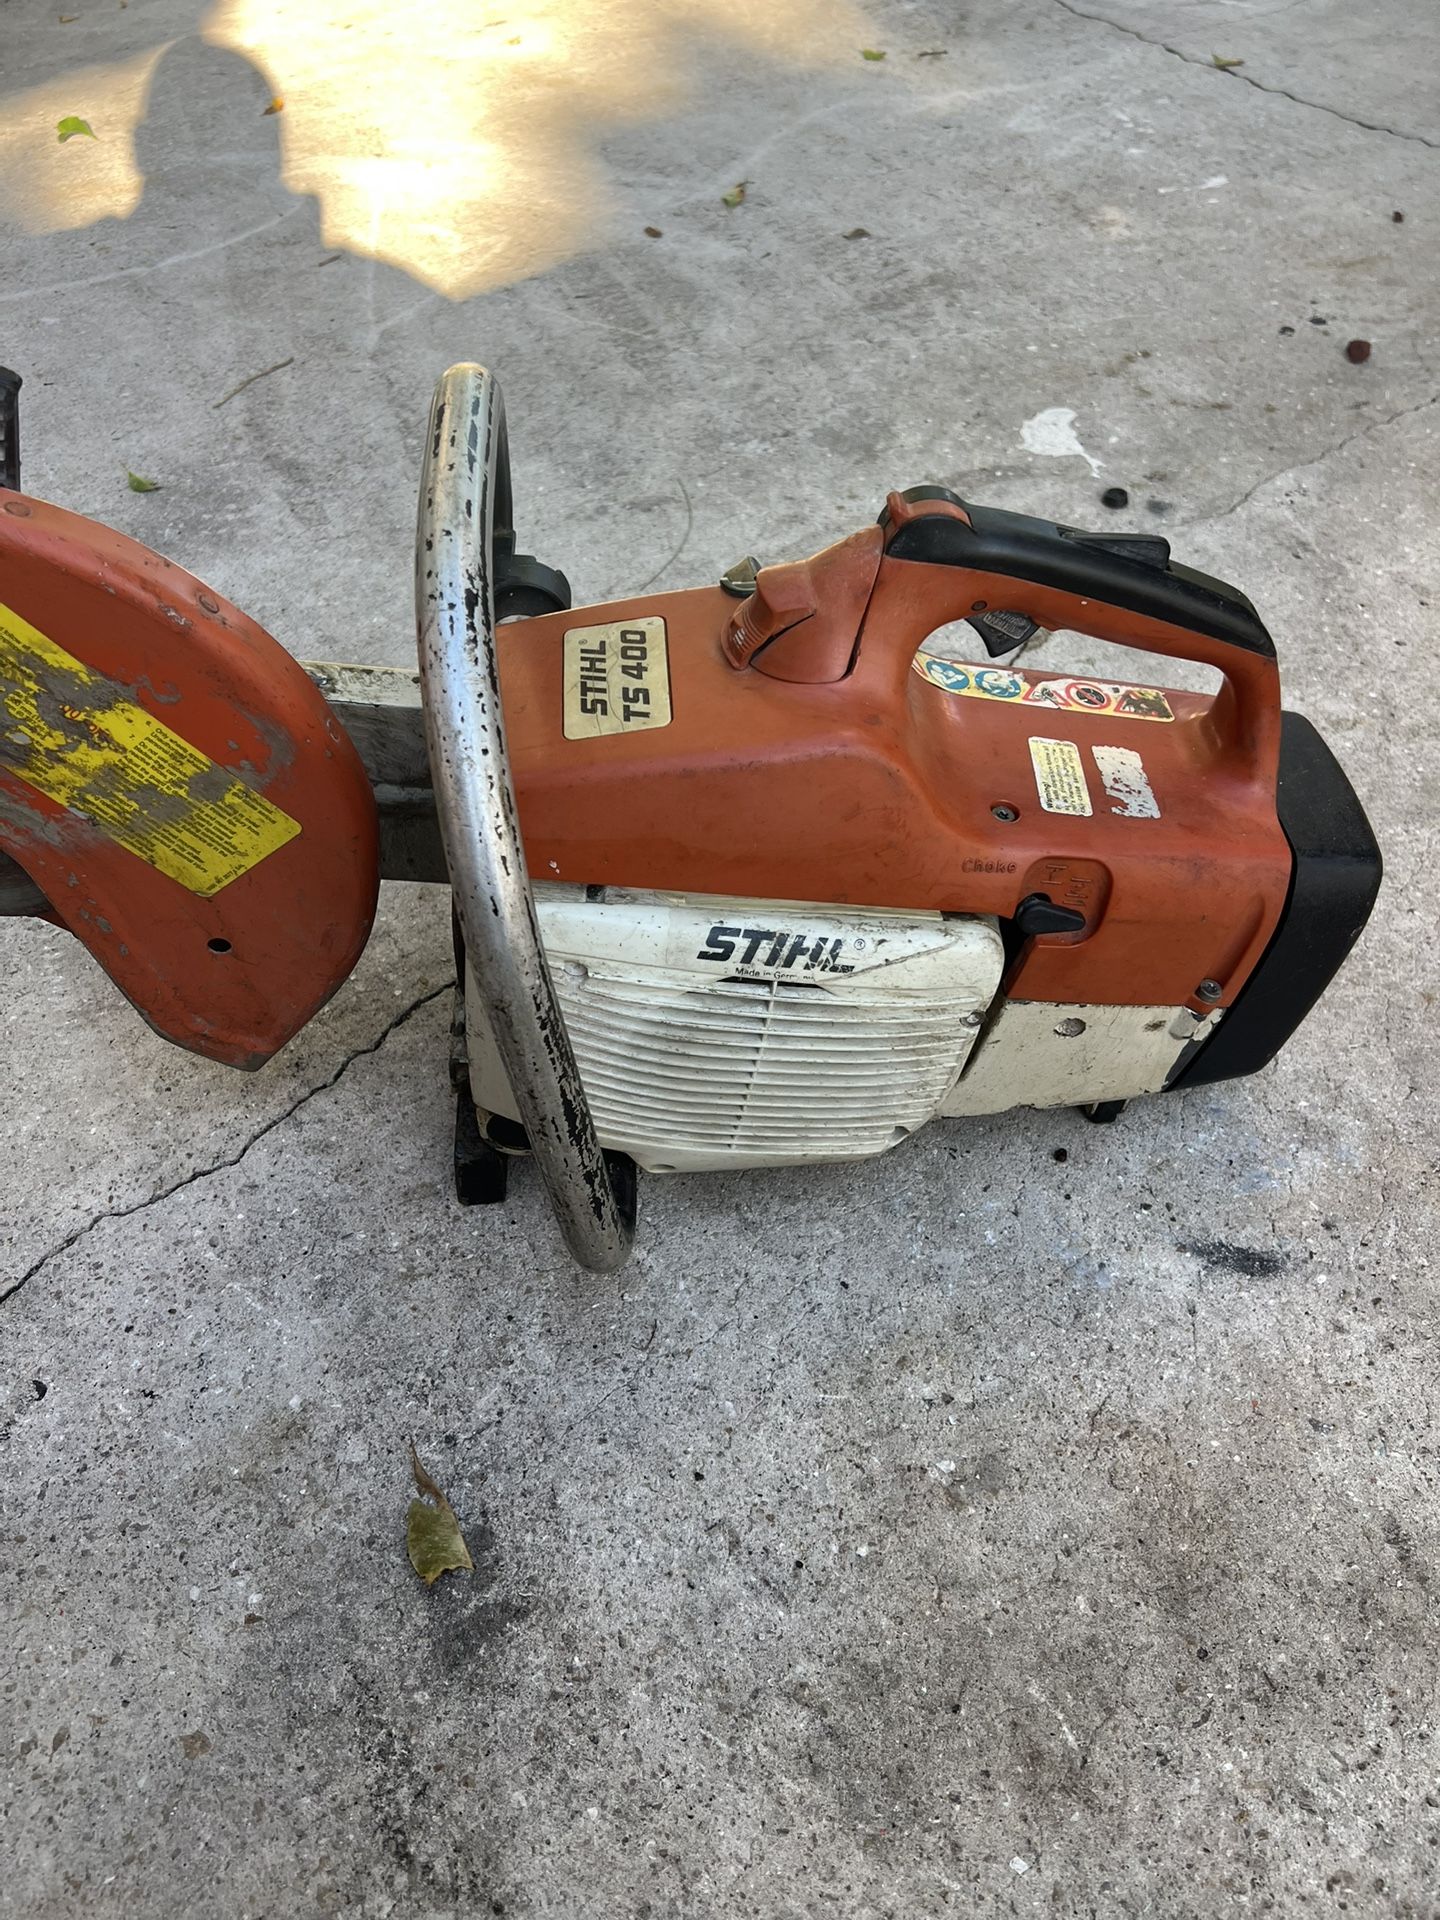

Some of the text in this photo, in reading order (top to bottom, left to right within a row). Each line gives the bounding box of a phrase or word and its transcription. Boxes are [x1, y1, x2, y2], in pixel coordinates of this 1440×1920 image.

[580, 640, 607, 716] STIHL
[620, 629, 651, 722] TS 400
[1042, 781, 1055, 808] Warning!
[961, 857, 1016, 873] Choke
[696, 926, 855, 974] STIHL
[735, 967, 761, 977] Made
